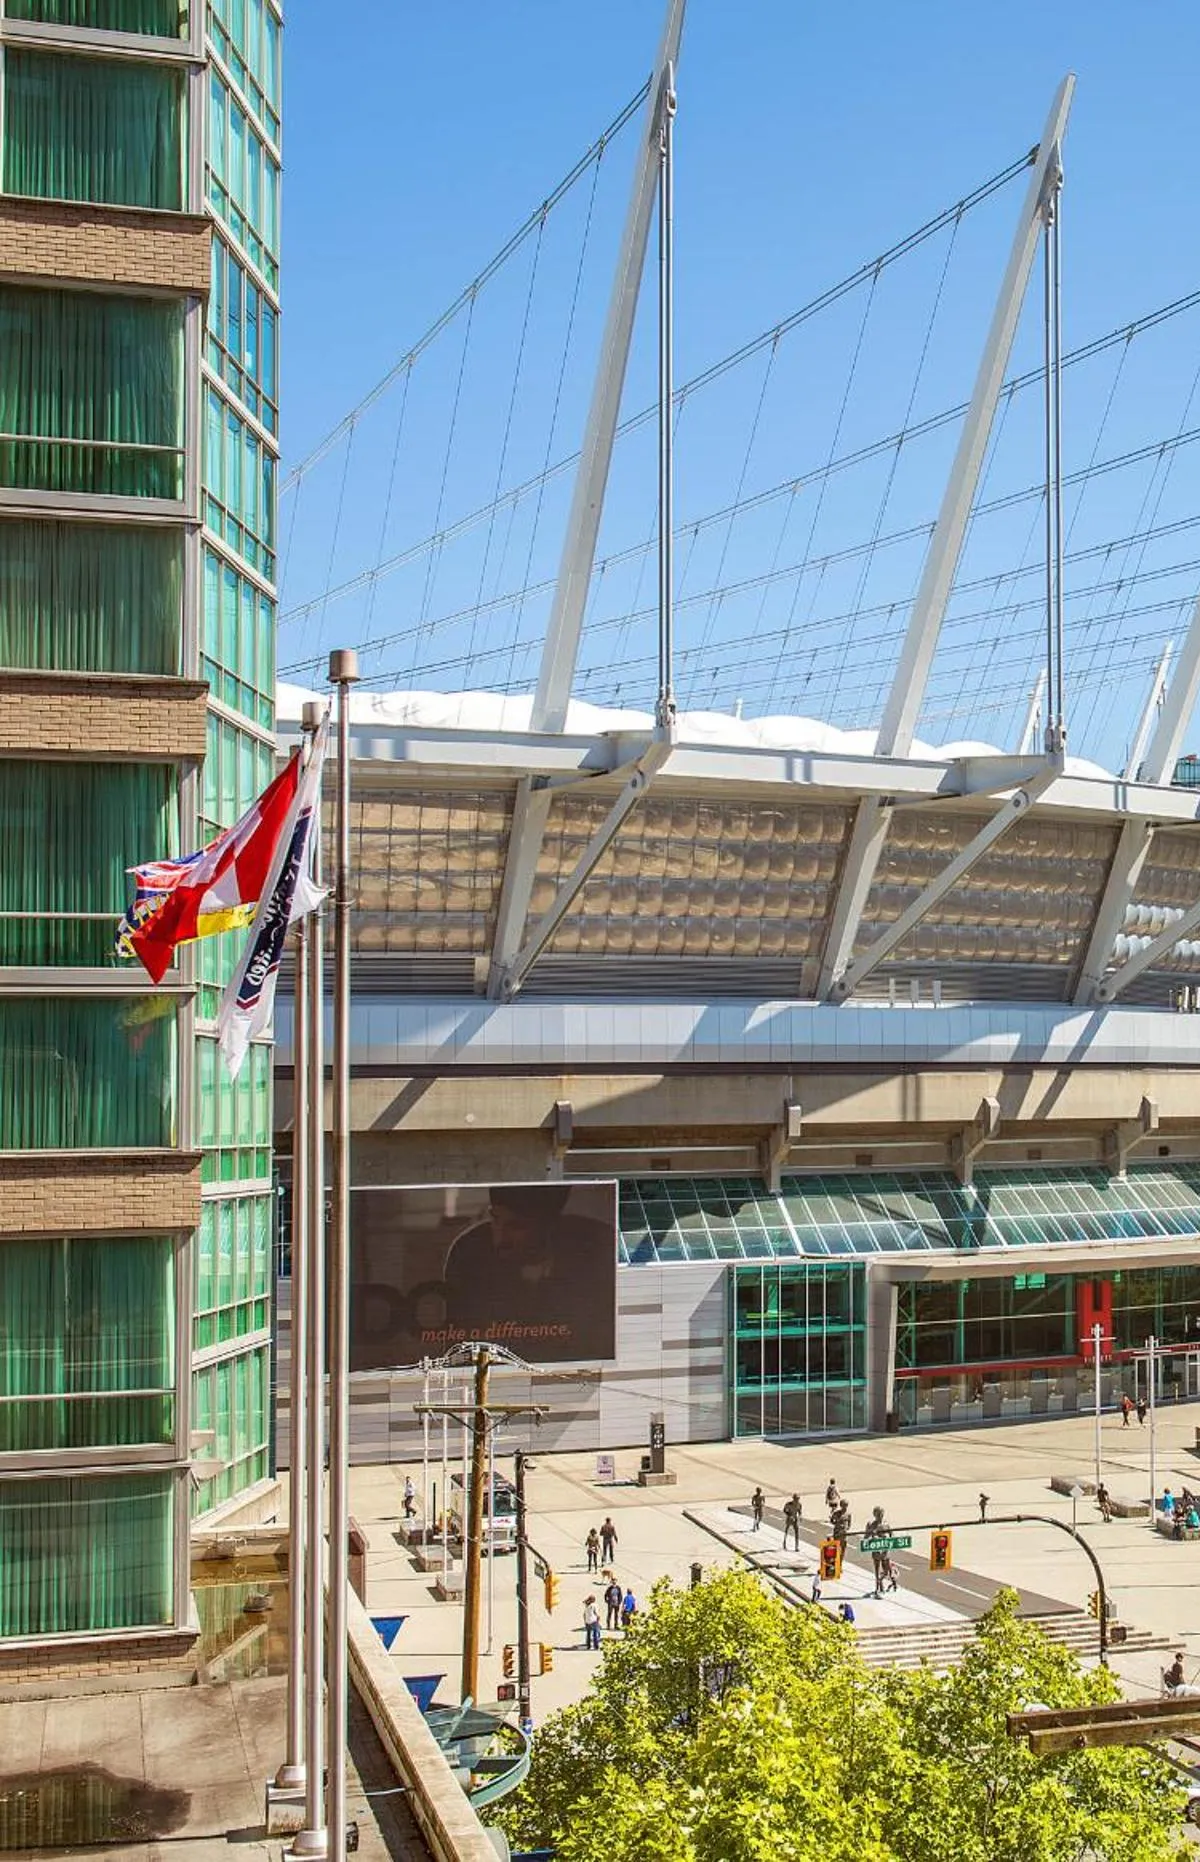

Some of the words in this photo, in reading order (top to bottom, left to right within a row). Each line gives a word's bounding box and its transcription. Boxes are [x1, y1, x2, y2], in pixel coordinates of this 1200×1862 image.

[421, 1324, 466, 1342] make
[470, 1328, 480, 1340] a
[485, 1320, 572, 1339] difference.
[897, 1538, 909, 1547] St
